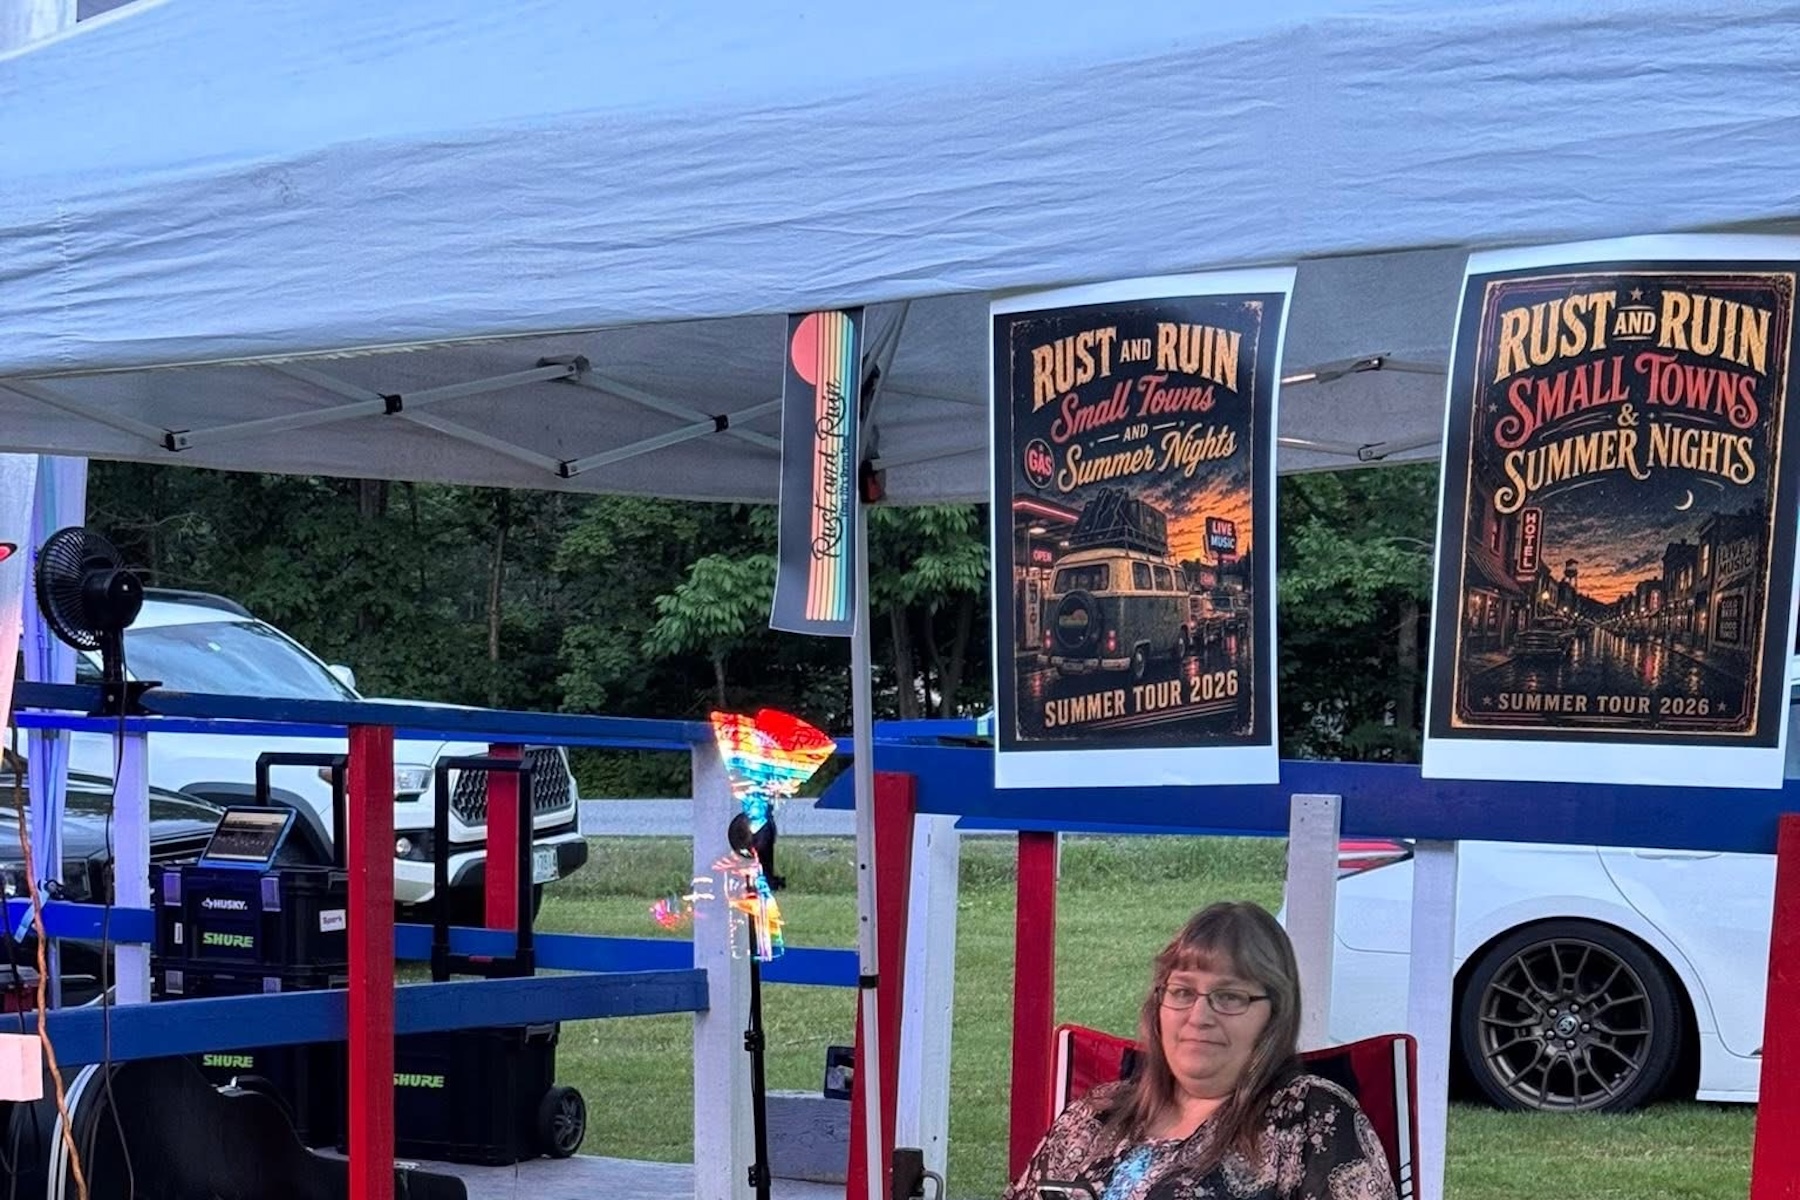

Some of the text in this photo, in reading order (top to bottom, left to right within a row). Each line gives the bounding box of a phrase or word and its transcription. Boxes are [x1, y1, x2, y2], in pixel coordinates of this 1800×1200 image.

[1493, 290, 1772, 385] RUST AND RUIN
[1031, 322, 1242, 413] RUST AND RUIN
[1051, 373, 1215, 444] Small Towns
[1494, 352, 1759, 449] SMALL TOWNS
[1617, 403, 1640, 427] &
[1123, 423, 1148, 442] AND
[812, 378, 846, 561] Rust and Ruin
[1028, 449, 1052, 476] GAS
[1058, 423, 1237, 492] Summer Nights
[1494, 423, 1756, 515] SUMMER NIGHTS
[1212, 521, 1232, 536] LIVE
[1523, 513, 1537, 568] HOTEL
[1209, 534, 1235, 549] MUSIC
[1718, 544, 1744, 563] LIVE
[1033, 550, 1052, 562] OPEN
[1719, 553, 1751, 573] MUSIC
[1045, 669, 1238, 728] SUMMER TOUR 2026
[1498, 693, 1709, 715] SUMMER TOUR 2026
[203, 932, 254, 948] SHURE
[203, 1054, 254, 1069] SHURE
